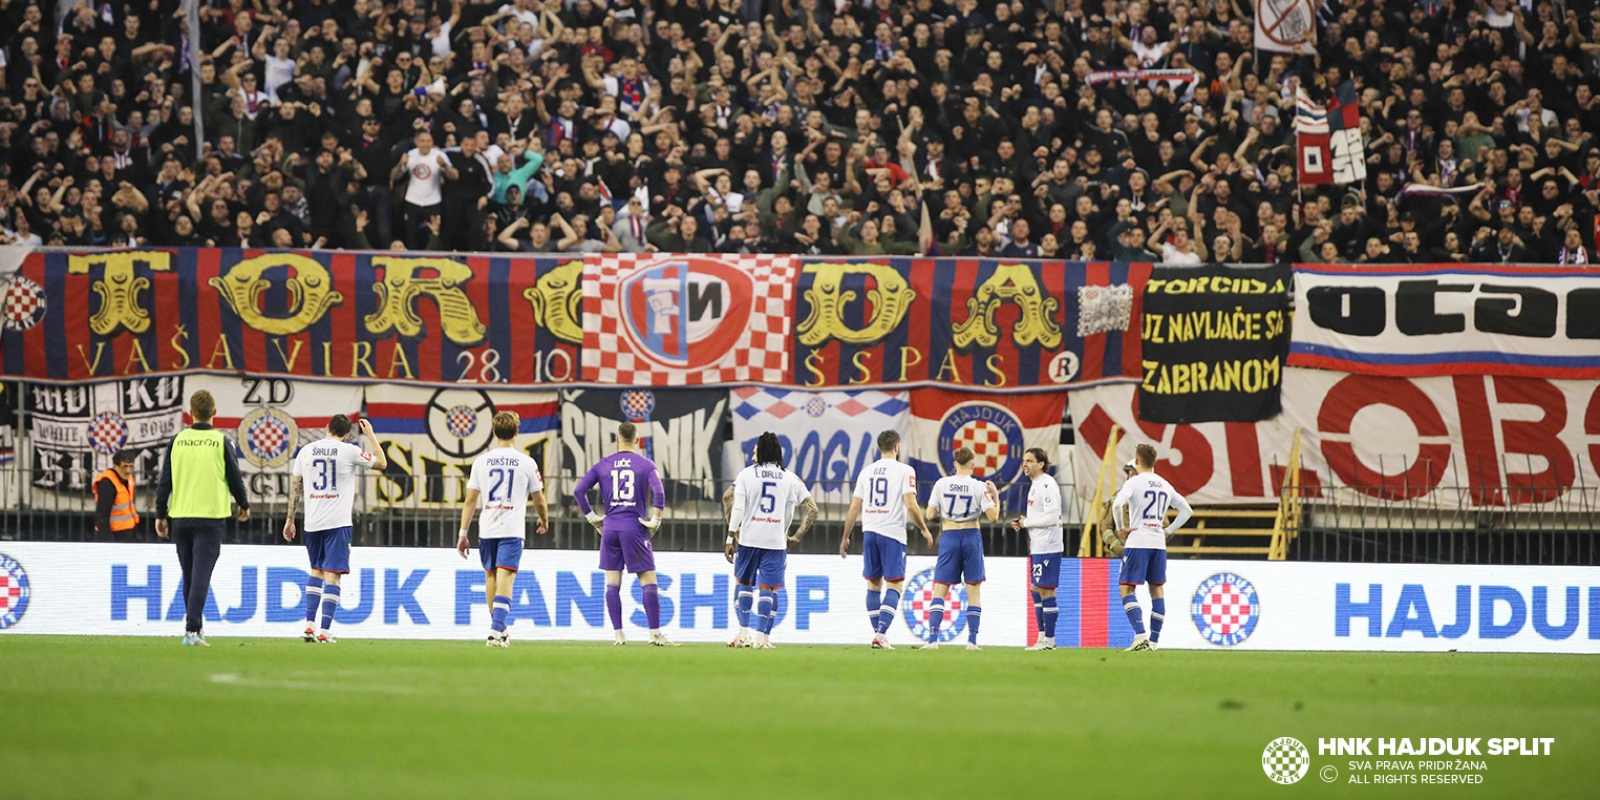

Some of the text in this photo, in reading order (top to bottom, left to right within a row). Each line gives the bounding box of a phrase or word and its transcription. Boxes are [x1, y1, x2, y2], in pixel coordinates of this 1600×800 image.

[1147, 276, 1285, 294] TORCIDA
[1168, 306, 1261, 343] NAVIJAČE
[77, 323, 236, 376] VAŠA
[272, 338, 415, 379] VIRA
[1142, 355, 1280, 395] ZABRANOM
[240, 378, 293, 406] ZD
[948, 406, 1016, 434] HAJDUK
[177, 438, 220, 448] macron
[312, 458, 337, 491] 31
[486, 457, 520, 467] PUKŠTAS
[488, 468, 515, 502] 21
[610, 469, 635, 501] 13
[760, 481, 777, 513] 5
[869, 477, 888, 507] 19
[943, 493, 973, 518] 77
[1143, 490, 1168, 521] 20
[454, 569, 608, 627] FAN
[1197, 573, 1256, 598] HAJDUK
[1334, 582, 1600, 641] HAJDU
[1201, 627, 1248, 646] SPLIT
